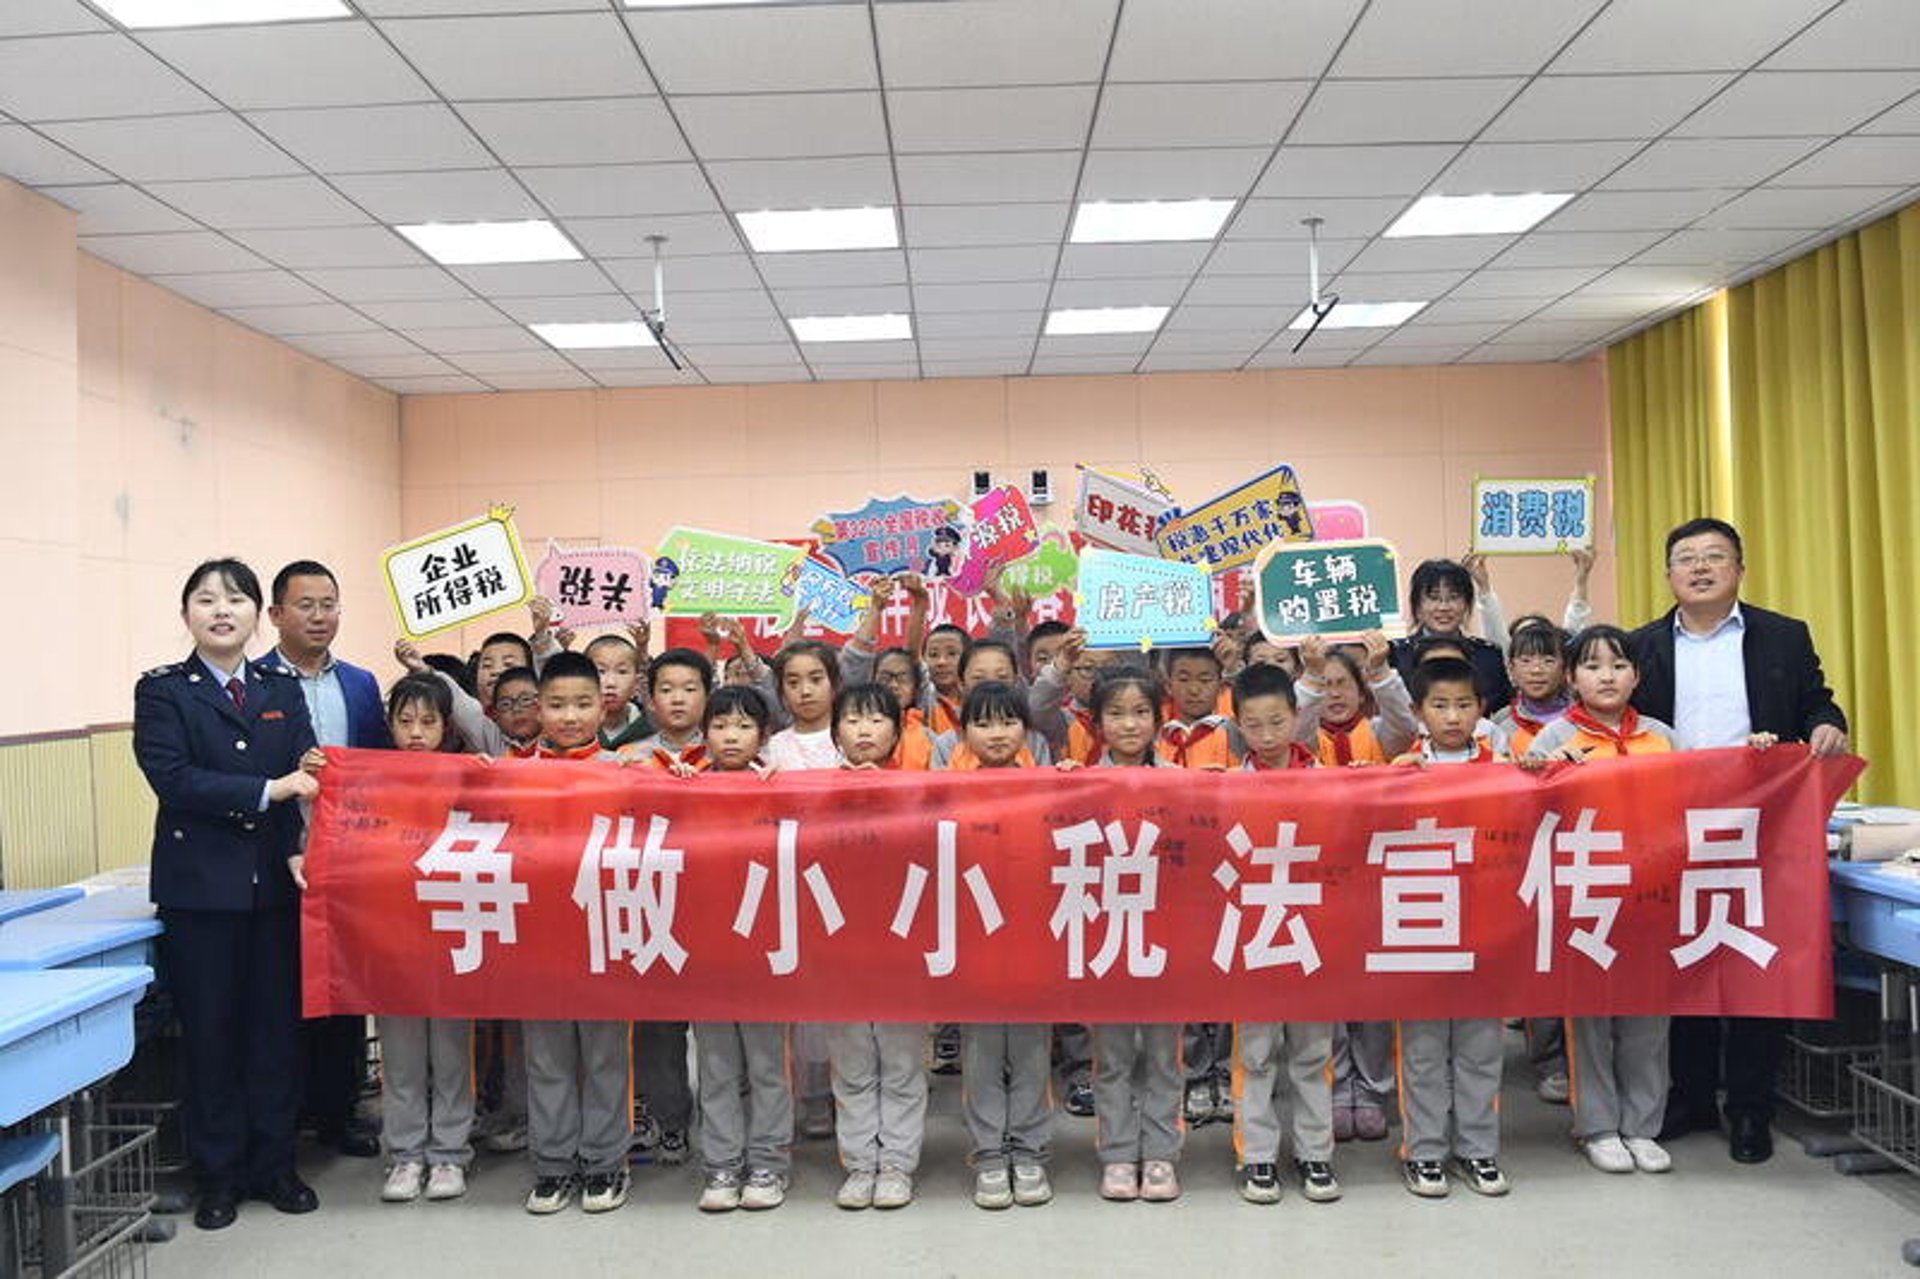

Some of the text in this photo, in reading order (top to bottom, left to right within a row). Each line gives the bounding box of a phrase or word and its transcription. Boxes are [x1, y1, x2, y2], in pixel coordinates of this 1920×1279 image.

[1166, 499, 1273, 552] 税惠千万家
[1480, 489, 1585, 538] 消费税
[420, 543, 479, 583] 企业
[677, 548, 779, 577] 依法纳税
[1291, 553, 1358, 587] 车辆
[414, 565, 507, 619] 所得税
[560, 566, 632, 612] 关税
[1098, 578, 1193, 620] 房产税
[1278, 584, 1380, 624] 购置税
[414, 808, 1779, 979] 争做小小税法宣传员
